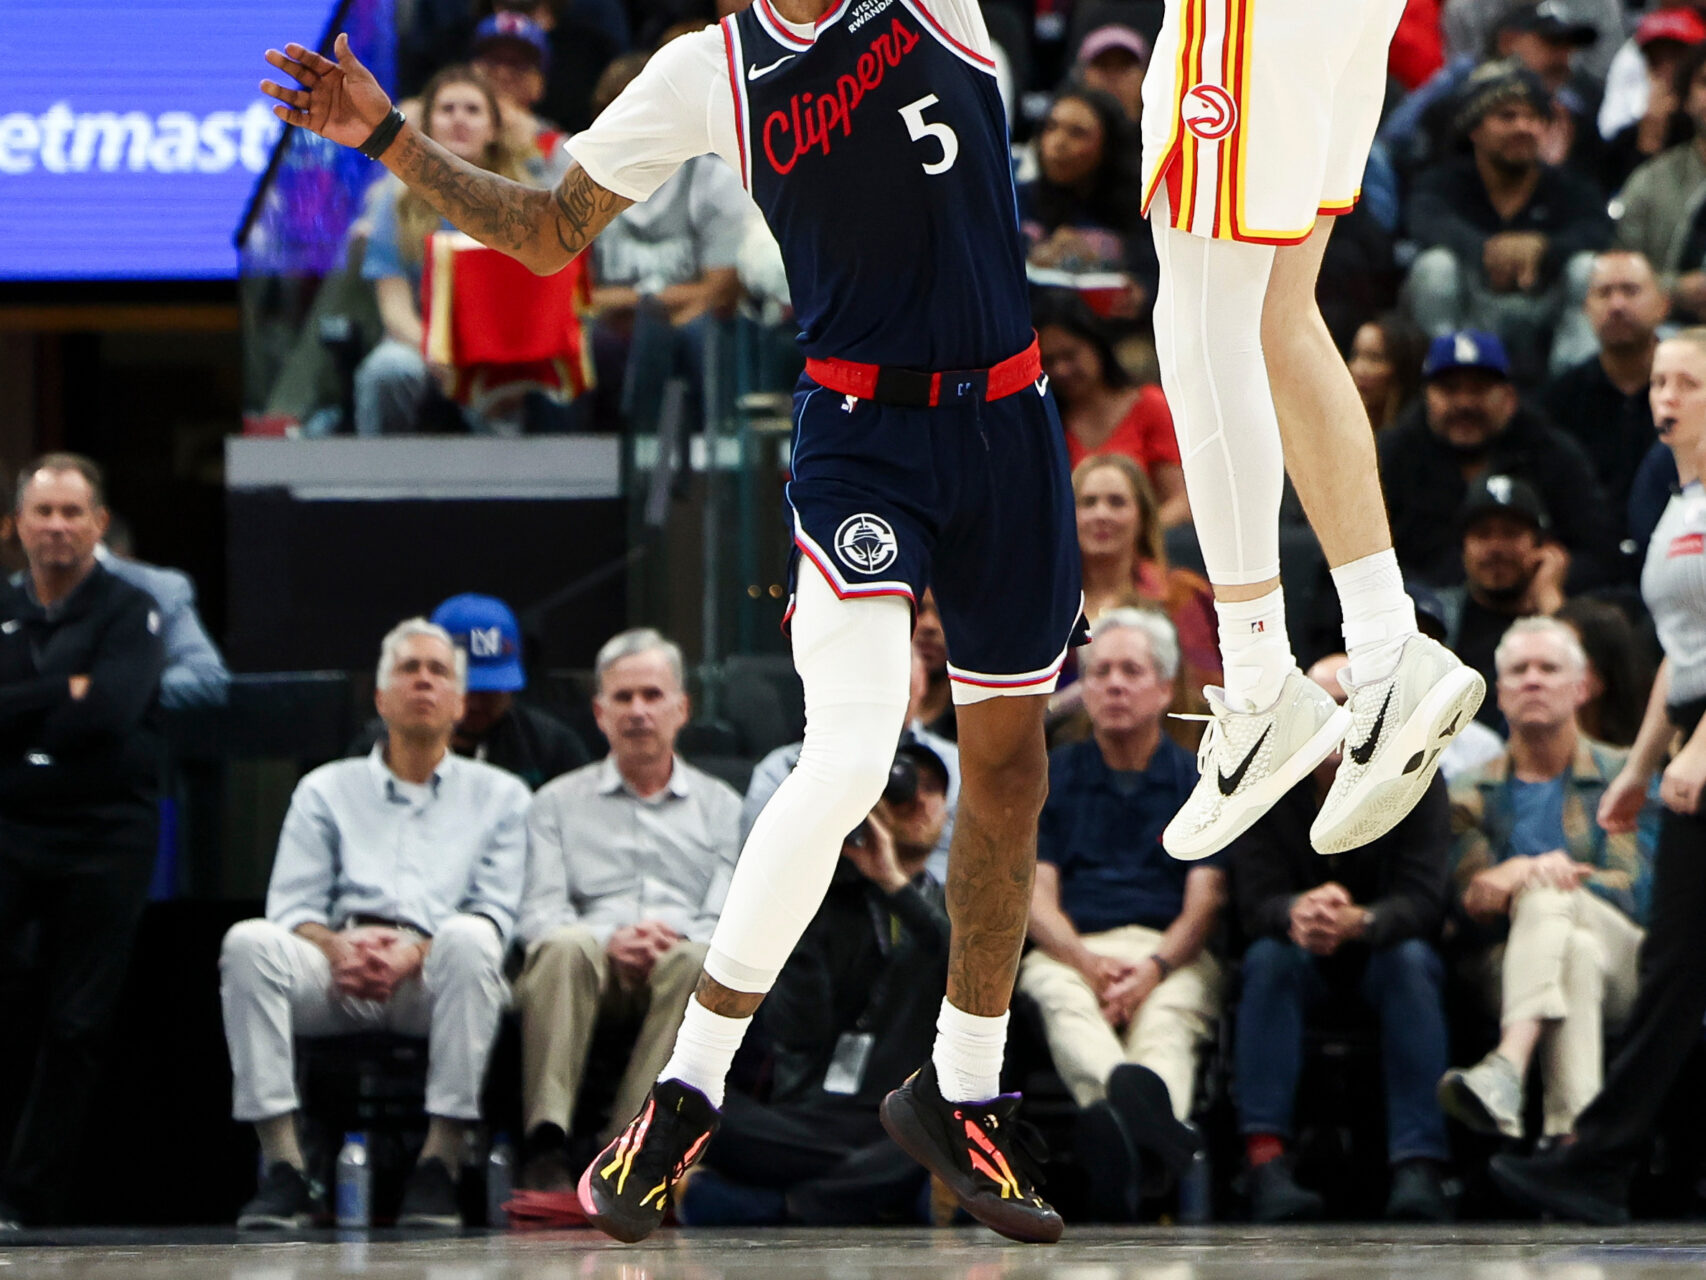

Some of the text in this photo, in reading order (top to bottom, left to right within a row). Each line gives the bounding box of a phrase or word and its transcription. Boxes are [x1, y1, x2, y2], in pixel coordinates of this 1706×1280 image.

[0, 100, 281, 173] etmast
[763, 18, 919, 175] Clippers
[898, 93, 959, 175] 5
